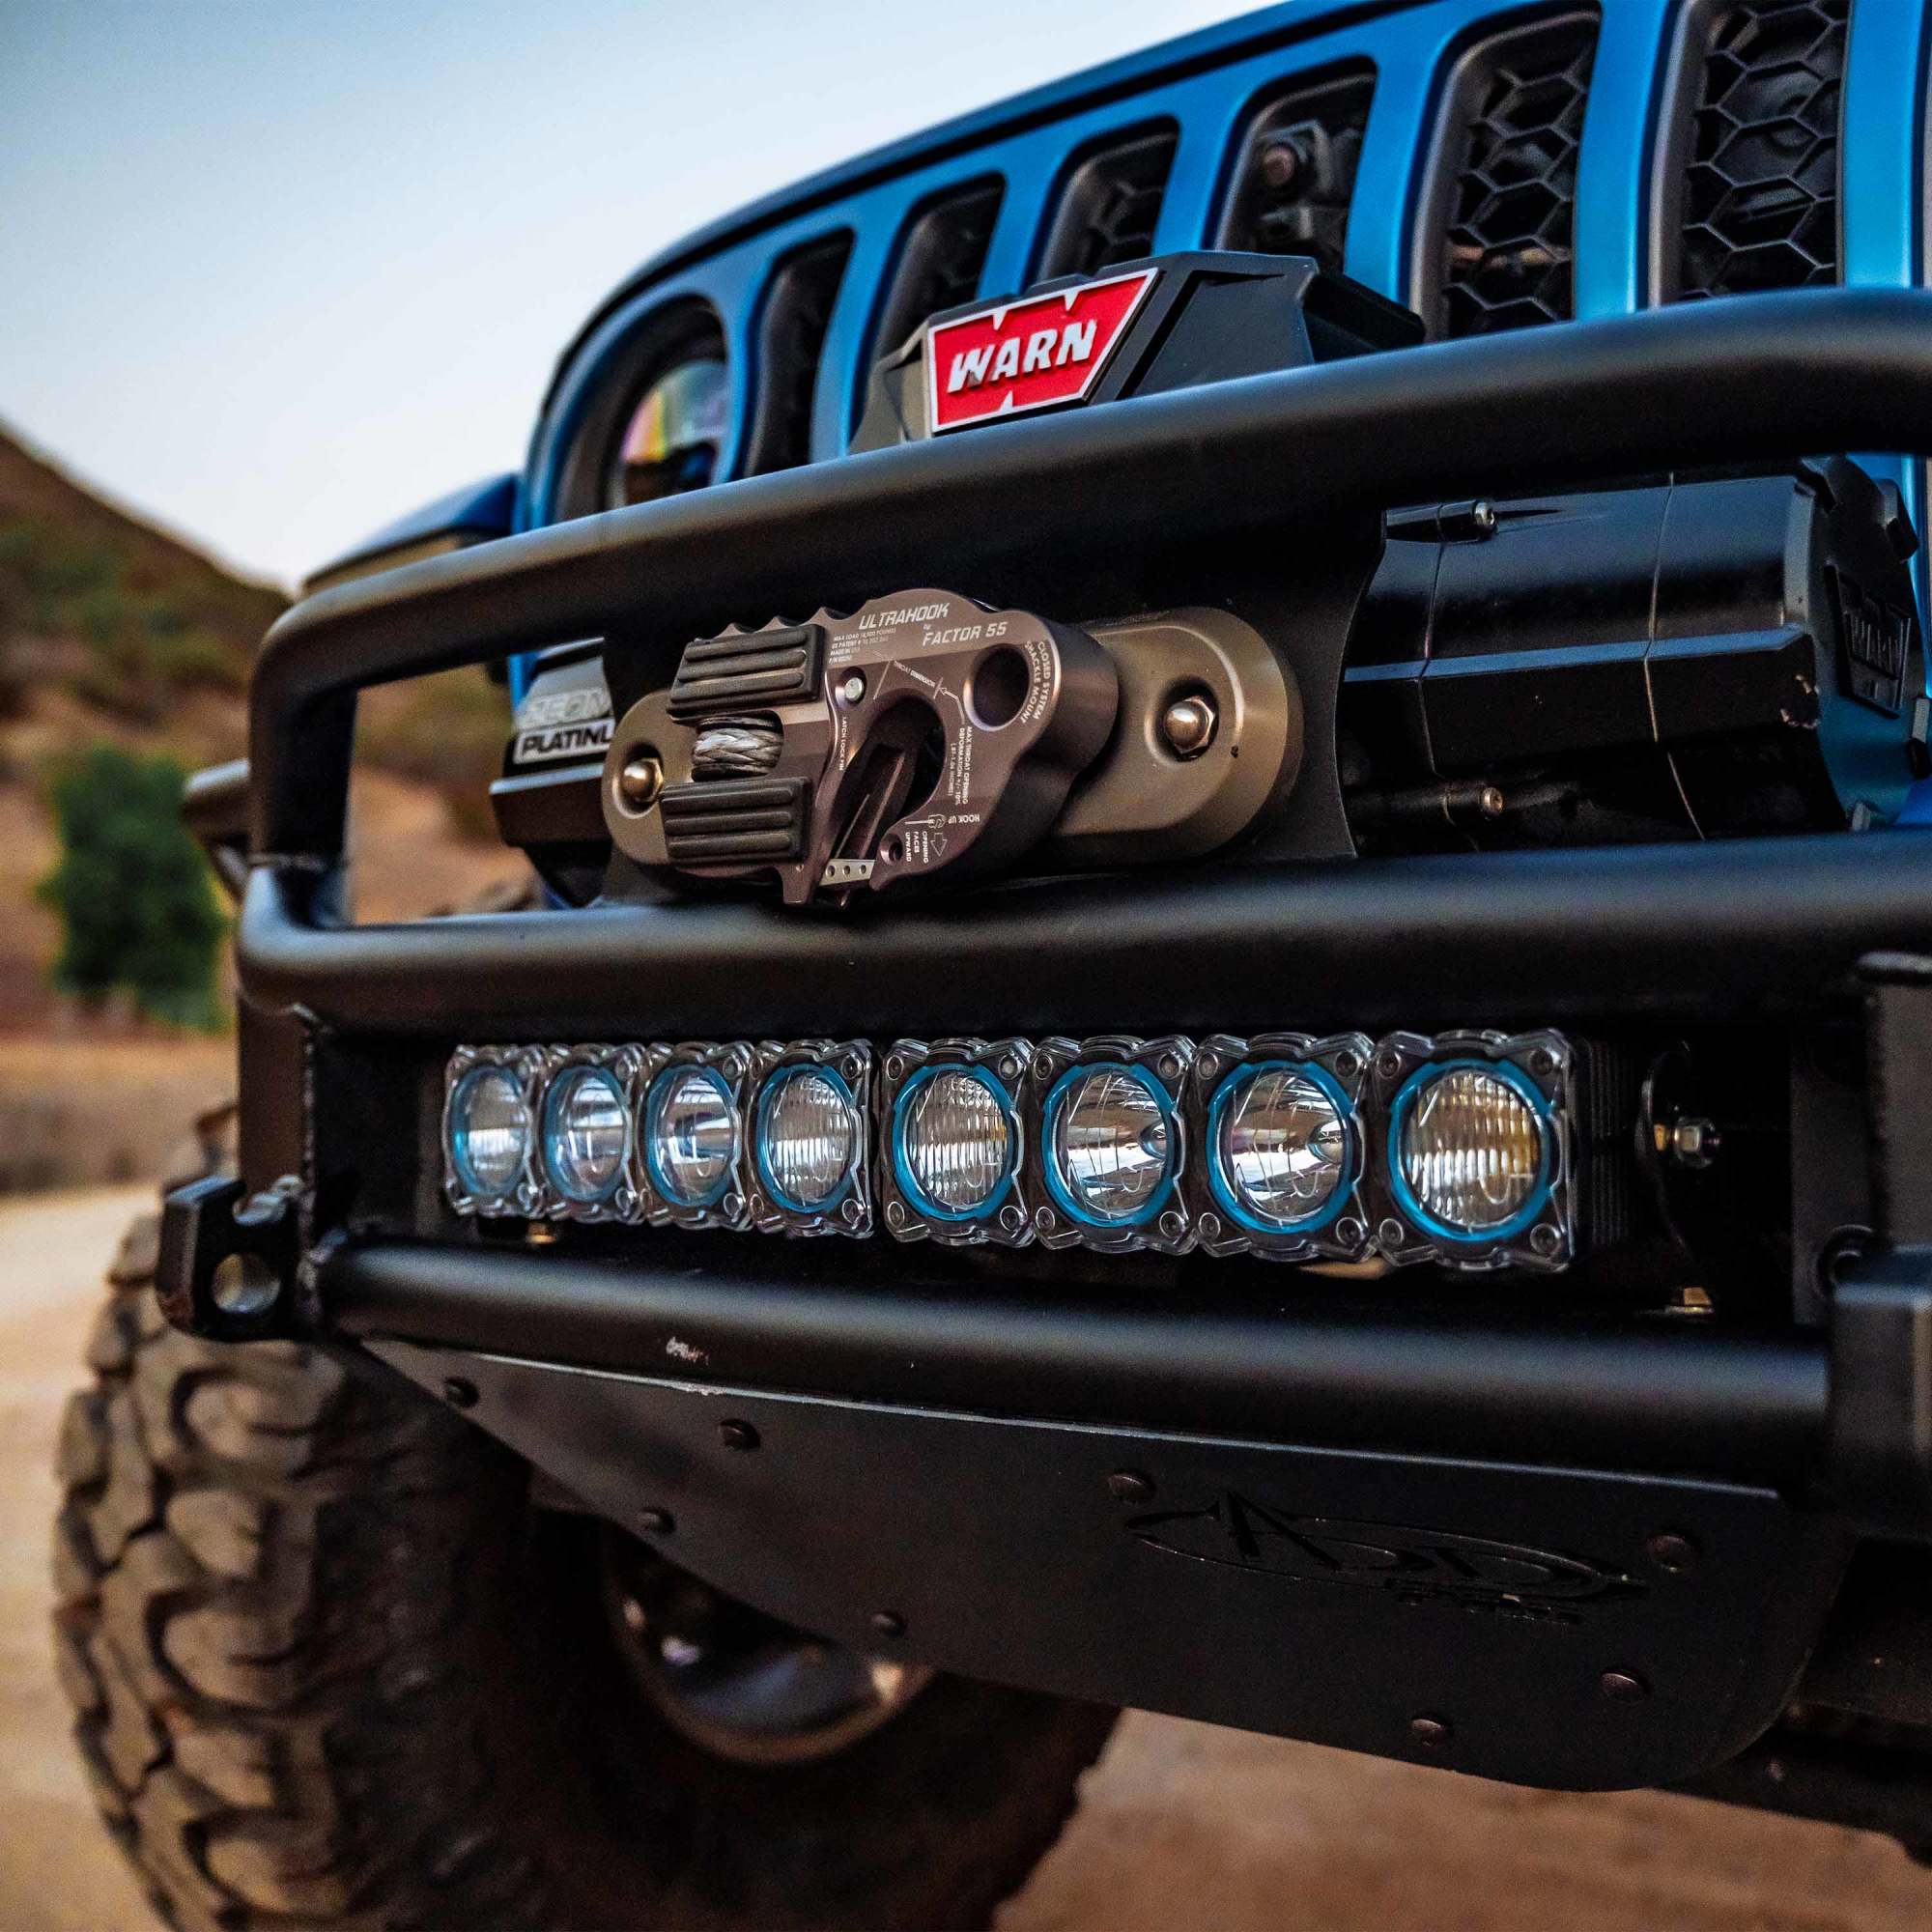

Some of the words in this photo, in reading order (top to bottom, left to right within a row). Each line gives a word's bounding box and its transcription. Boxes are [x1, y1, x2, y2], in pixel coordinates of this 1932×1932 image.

[947, 319, 1097, 394] WARN
[858, 603, 951, 630] ULTRAHOOK
[922, 626, 982, 647] FACTOR
[985, 621, 1009, 638] 55
[1024, 639, 1041, 684] SHACKLE
[1037, 640, 1051, 680] CLOSED
[1020, 686, 1040, 724] MOUNT
[1032, 682, 1050, 720] SYSTEM
[948, 815, 957, 824] UP
[957, 813, 980, 824] HOOK
